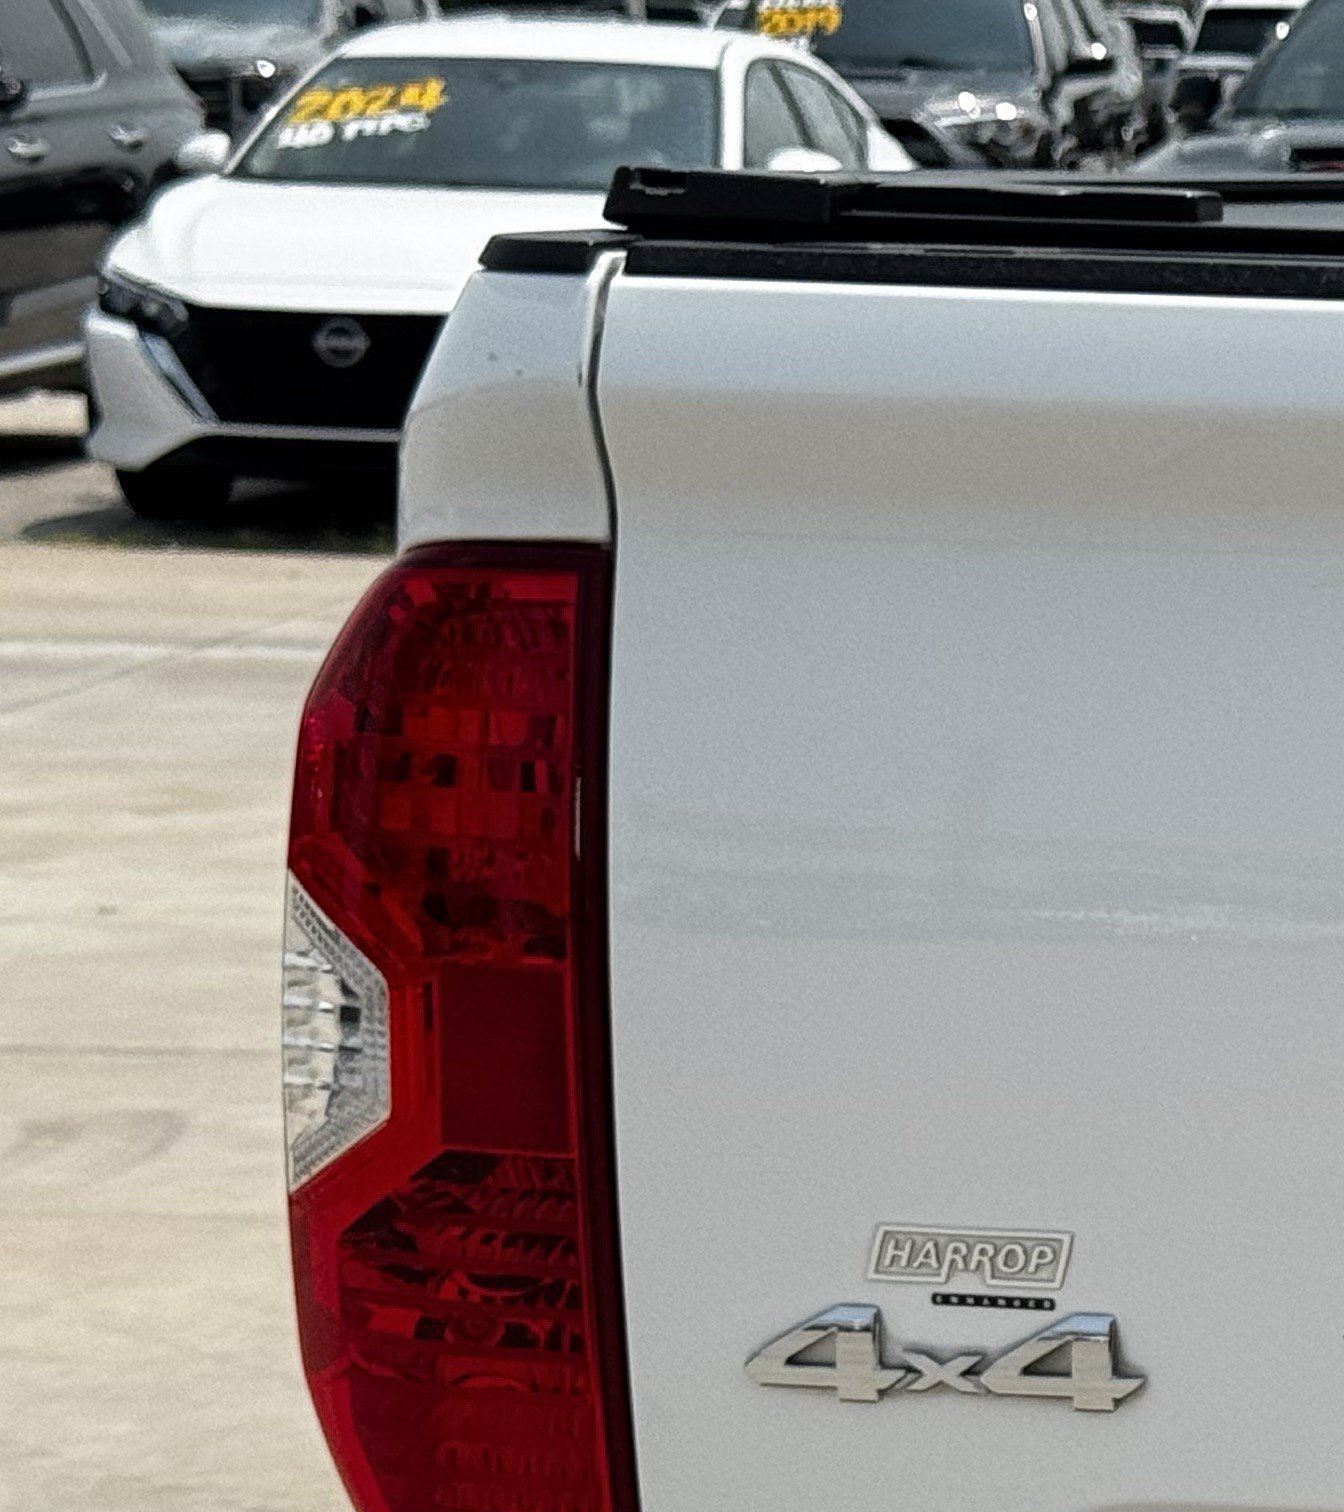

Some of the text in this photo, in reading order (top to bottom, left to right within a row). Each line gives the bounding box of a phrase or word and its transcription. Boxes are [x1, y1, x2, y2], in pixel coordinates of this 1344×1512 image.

[286, 76, 446, 123] 2024
[882, 1238, 1056, 1274] HARROP
[745, 1303, 1148, 1411] 4x4
